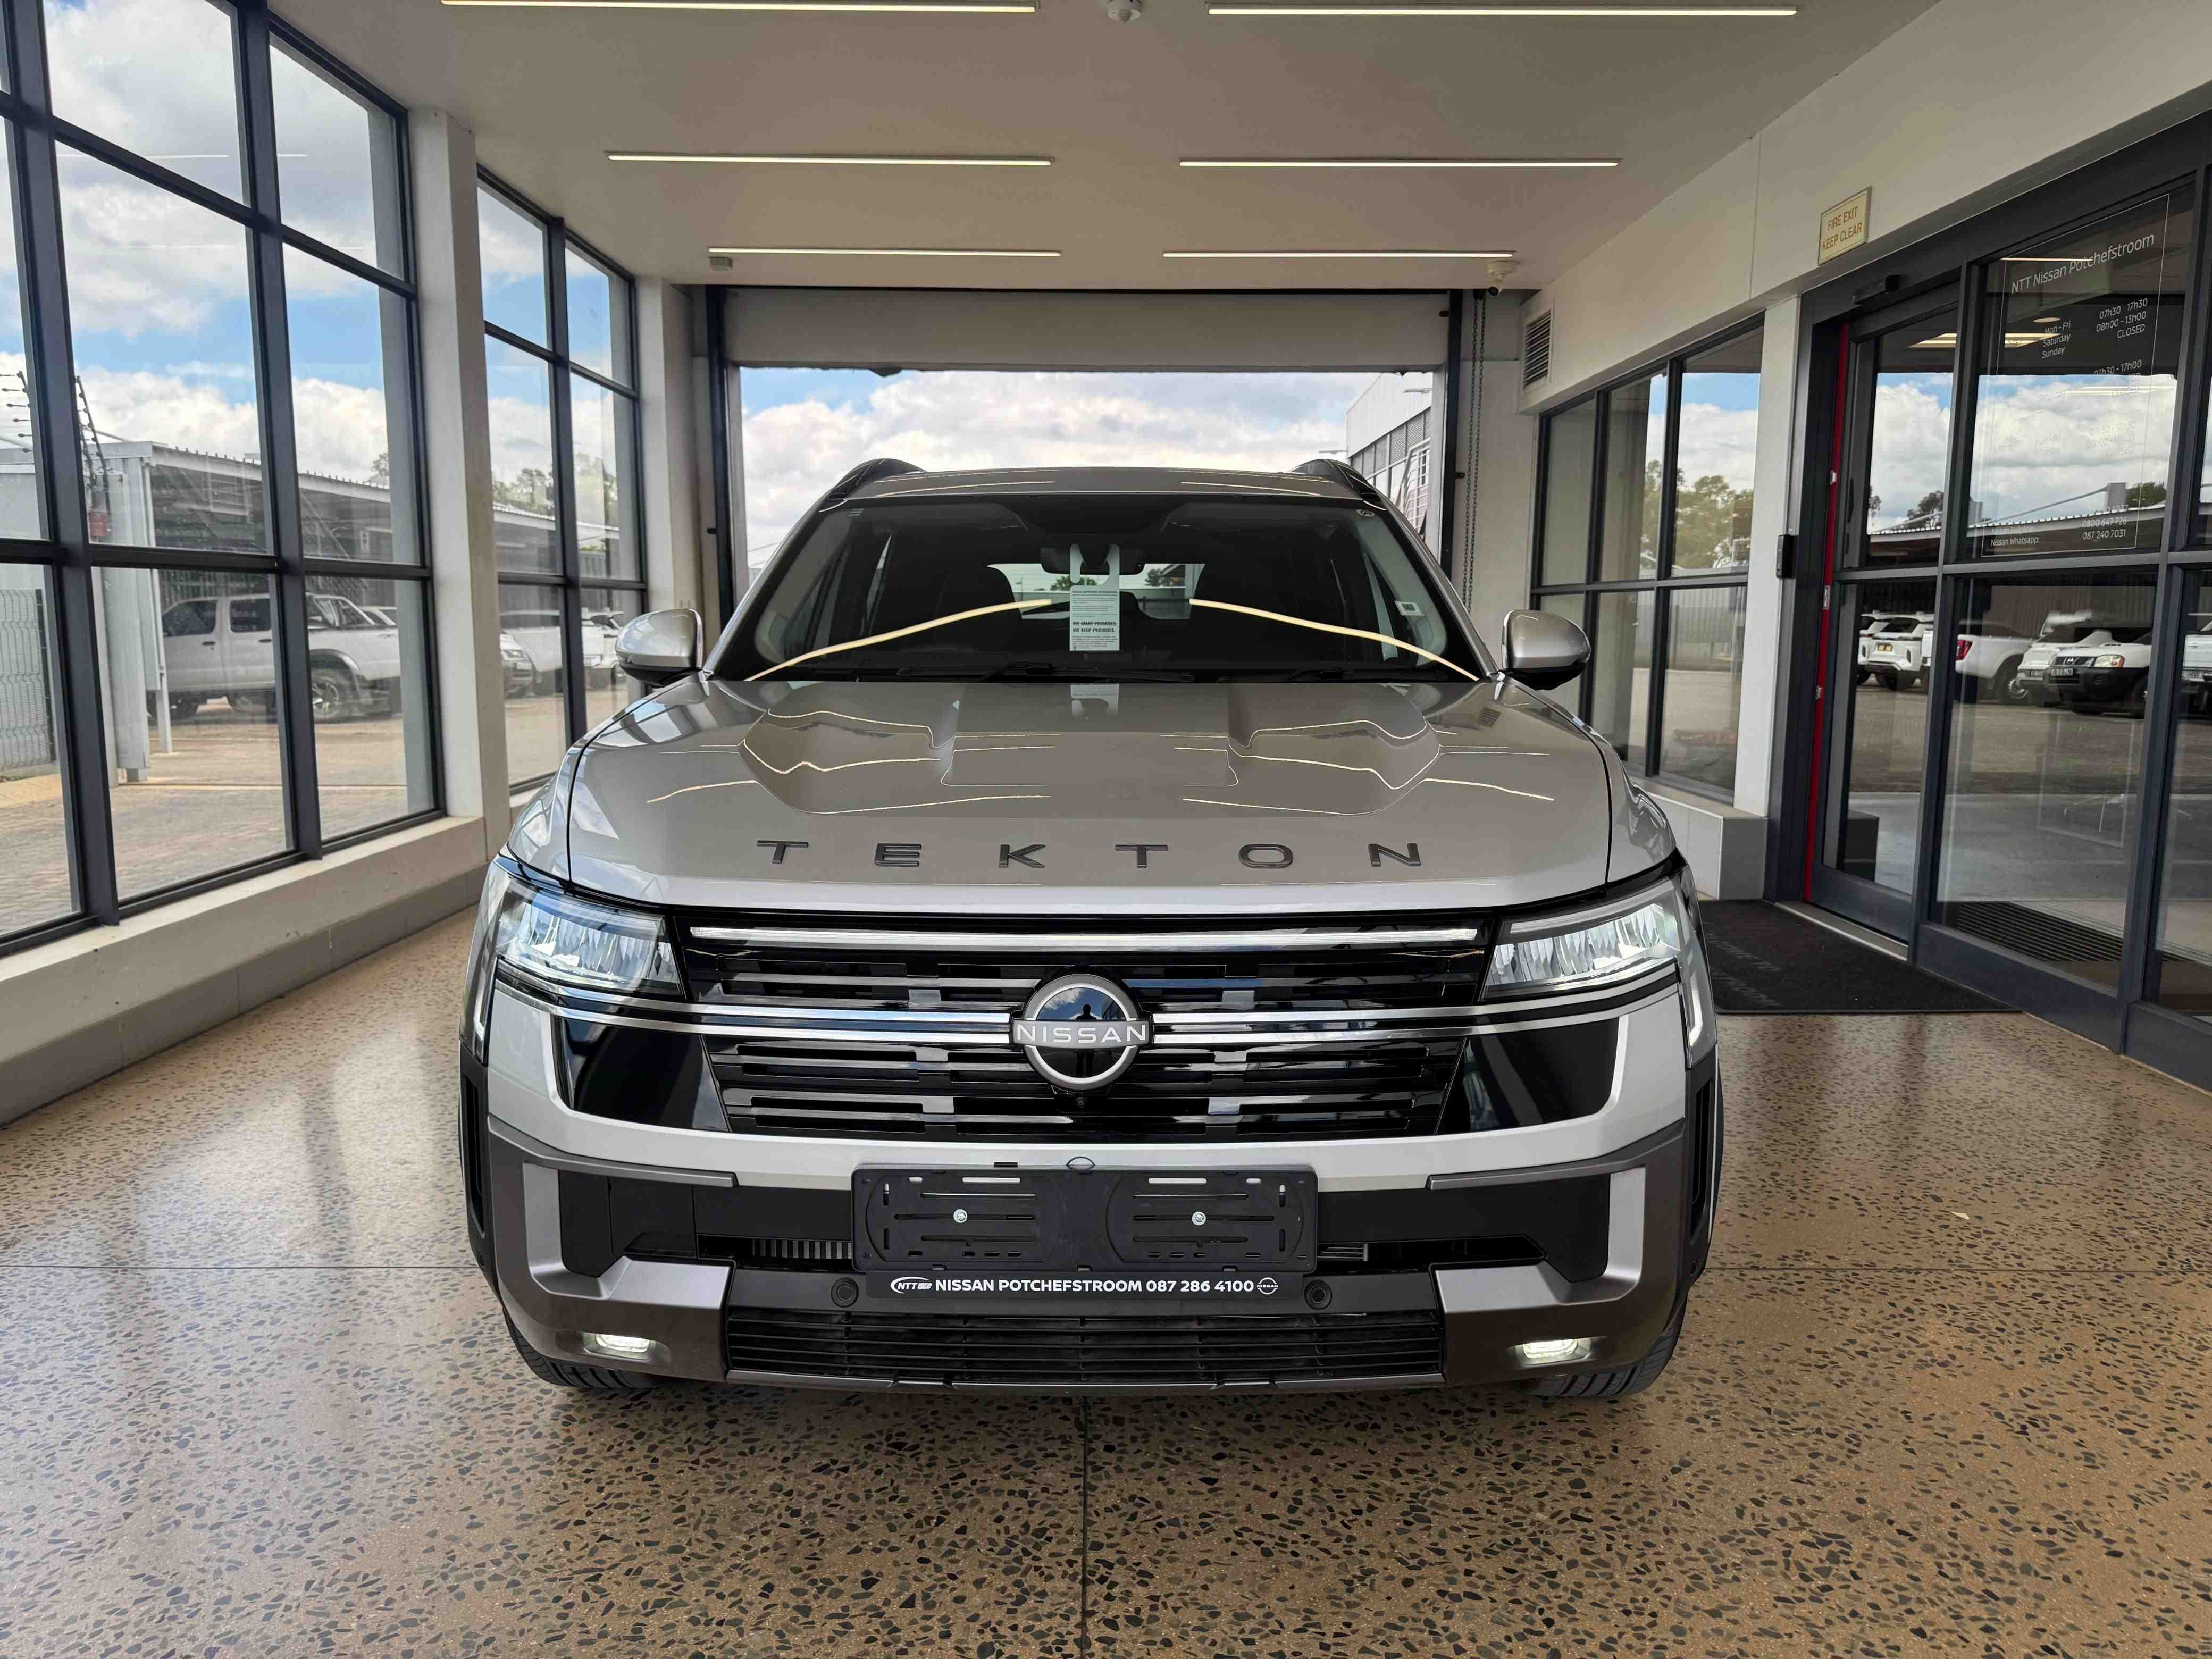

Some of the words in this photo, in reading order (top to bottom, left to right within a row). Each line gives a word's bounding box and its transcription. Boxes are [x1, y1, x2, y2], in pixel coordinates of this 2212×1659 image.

[1828, 215, 1841, 231] FIRE
[1843, 206, 1858, 223] EXIT
[1822, 234, 1838, 251] KEEP
[1840, 222, 1863, 242] CLEAR
[2012, 276, 2032, 294] NTT
[2033, 265, 2066, 286] Nissan
[2069, 234, 2154, 274] Potchefstroom
[2099, 306, 2121, 319] 07h30
[2127, 298, 2148, 311] 17h30
[2063, 320, 2071, 330] Fri
[2096, 319, 2119, 332] 08h00
[2125, 311, 2147, 324] 13h00
[2116, 324, 2146, 338] CLOSED
[2043, 333, 2071, 347] Saturday
[2041, 346, 2065, 358] Sunday
[2121, 359, 2142, 372] 17h00
[2096, 530, 2109, 539] 240
[2110, 529, 2126, 538] 7031
[756, 840, 1422, 869] TEKTON
[1016, 1024, 1146, 1043] NISSAN
[935, 1279, 994, 1292] NISSAN
[999, 1279, 1142, 1292] POTCHEFSTROOM
[1146, 1280, 1177, 1292] 087
[1180, 1280, 1211, 1292] 286
[1214, 1280, 1254, 1292] 4100
